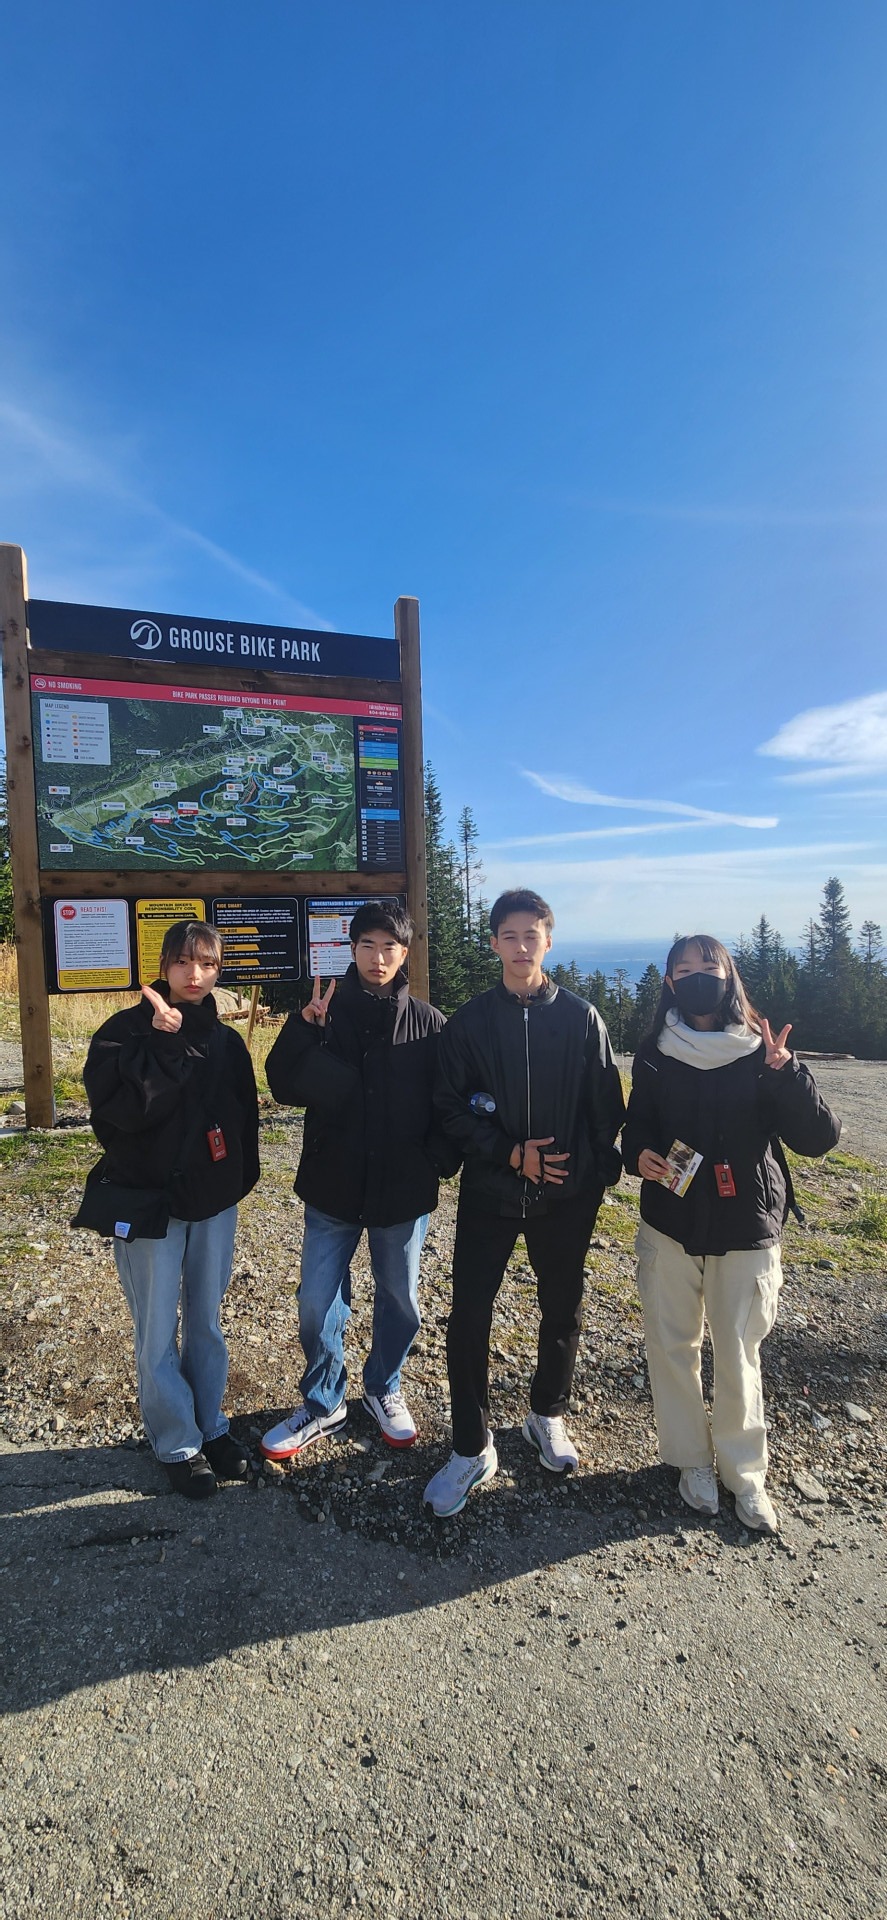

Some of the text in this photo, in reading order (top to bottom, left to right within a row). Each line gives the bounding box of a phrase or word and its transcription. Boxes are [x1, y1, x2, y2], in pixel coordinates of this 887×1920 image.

[169, 627, 321, 663] GROUSE BIKE PARK
[57, 681, 82, 690] SMOKING
[198, 693, 217, 701] PASSES
[217, 694, 241, 703] REQUIRED
[241, 696, 261, 704] BEYOND
[272, 698, 287, 706] POINT
